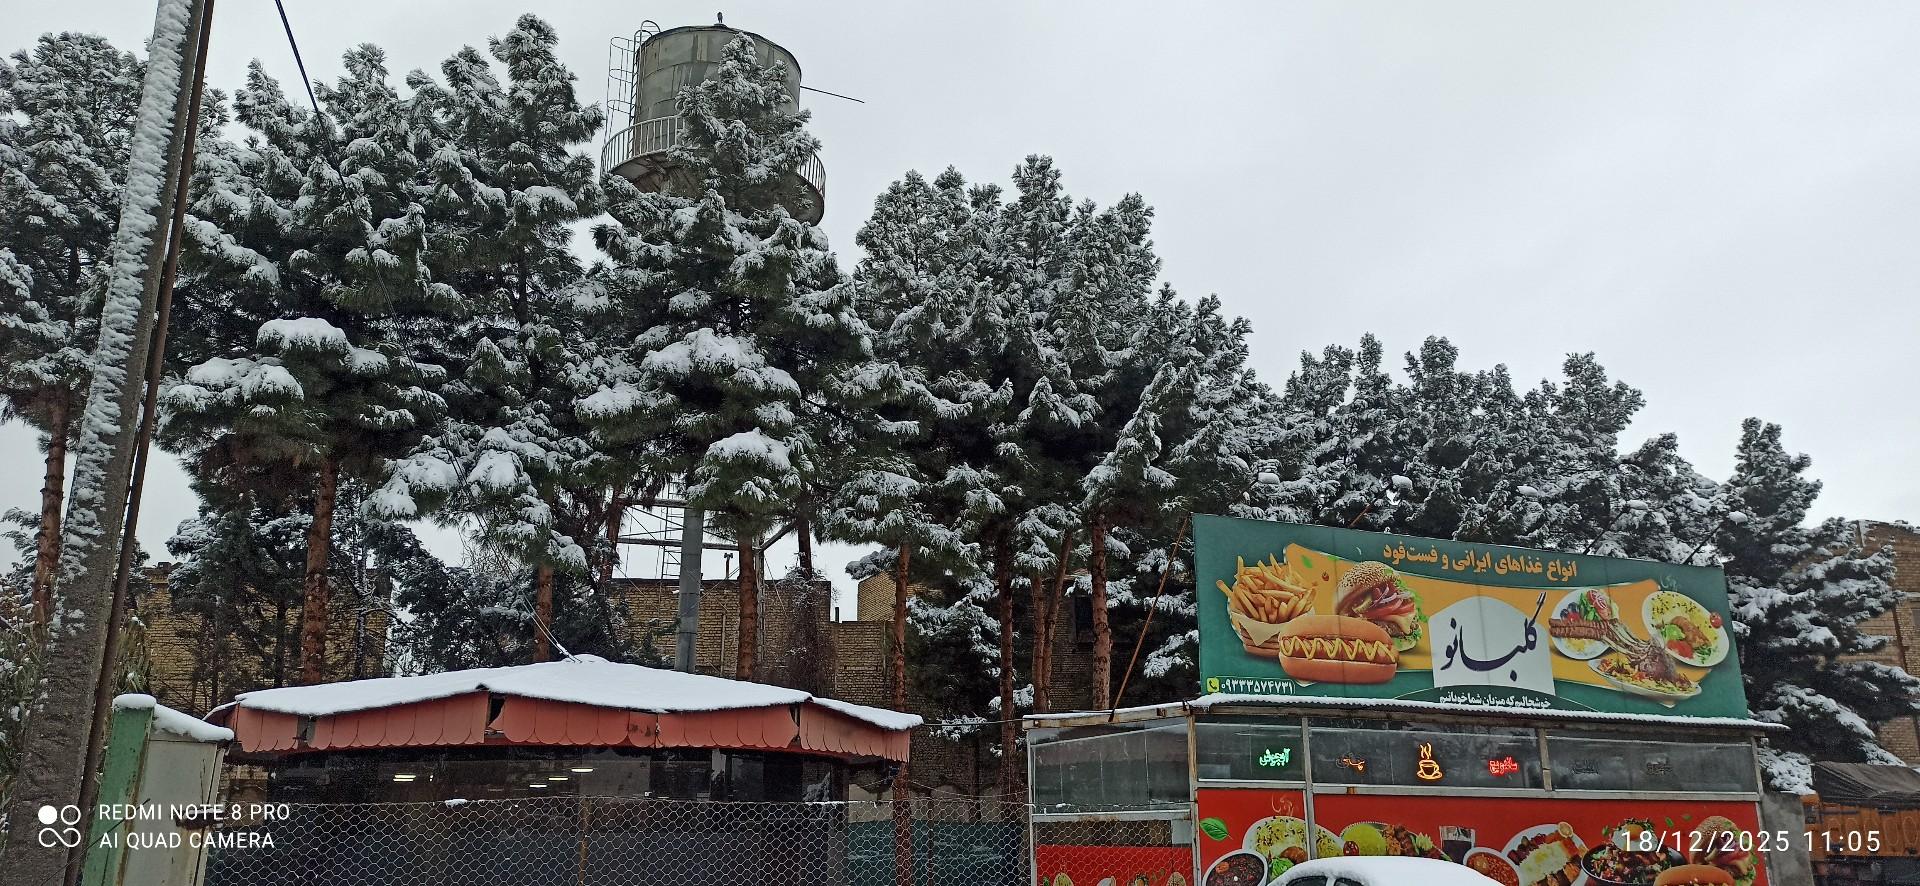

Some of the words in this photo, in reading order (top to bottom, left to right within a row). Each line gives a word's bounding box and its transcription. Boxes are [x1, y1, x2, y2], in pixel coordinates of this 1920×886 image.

[1441, 553, 1449, 570] و
[1452, 549, 1492, 573] ایرانی
[1495, 554, 1543, 575] غذاهای
[1547, 559, 1577, 582] انواع
[1440, 592, 1546, 682] گلبانو
[1221, 678, 1293, 694] ۰۹۳۳۳۵۷۴۷۳۱
[1468, 692, 1482, 704] شما
[1506, 695, 1515, 706] که
